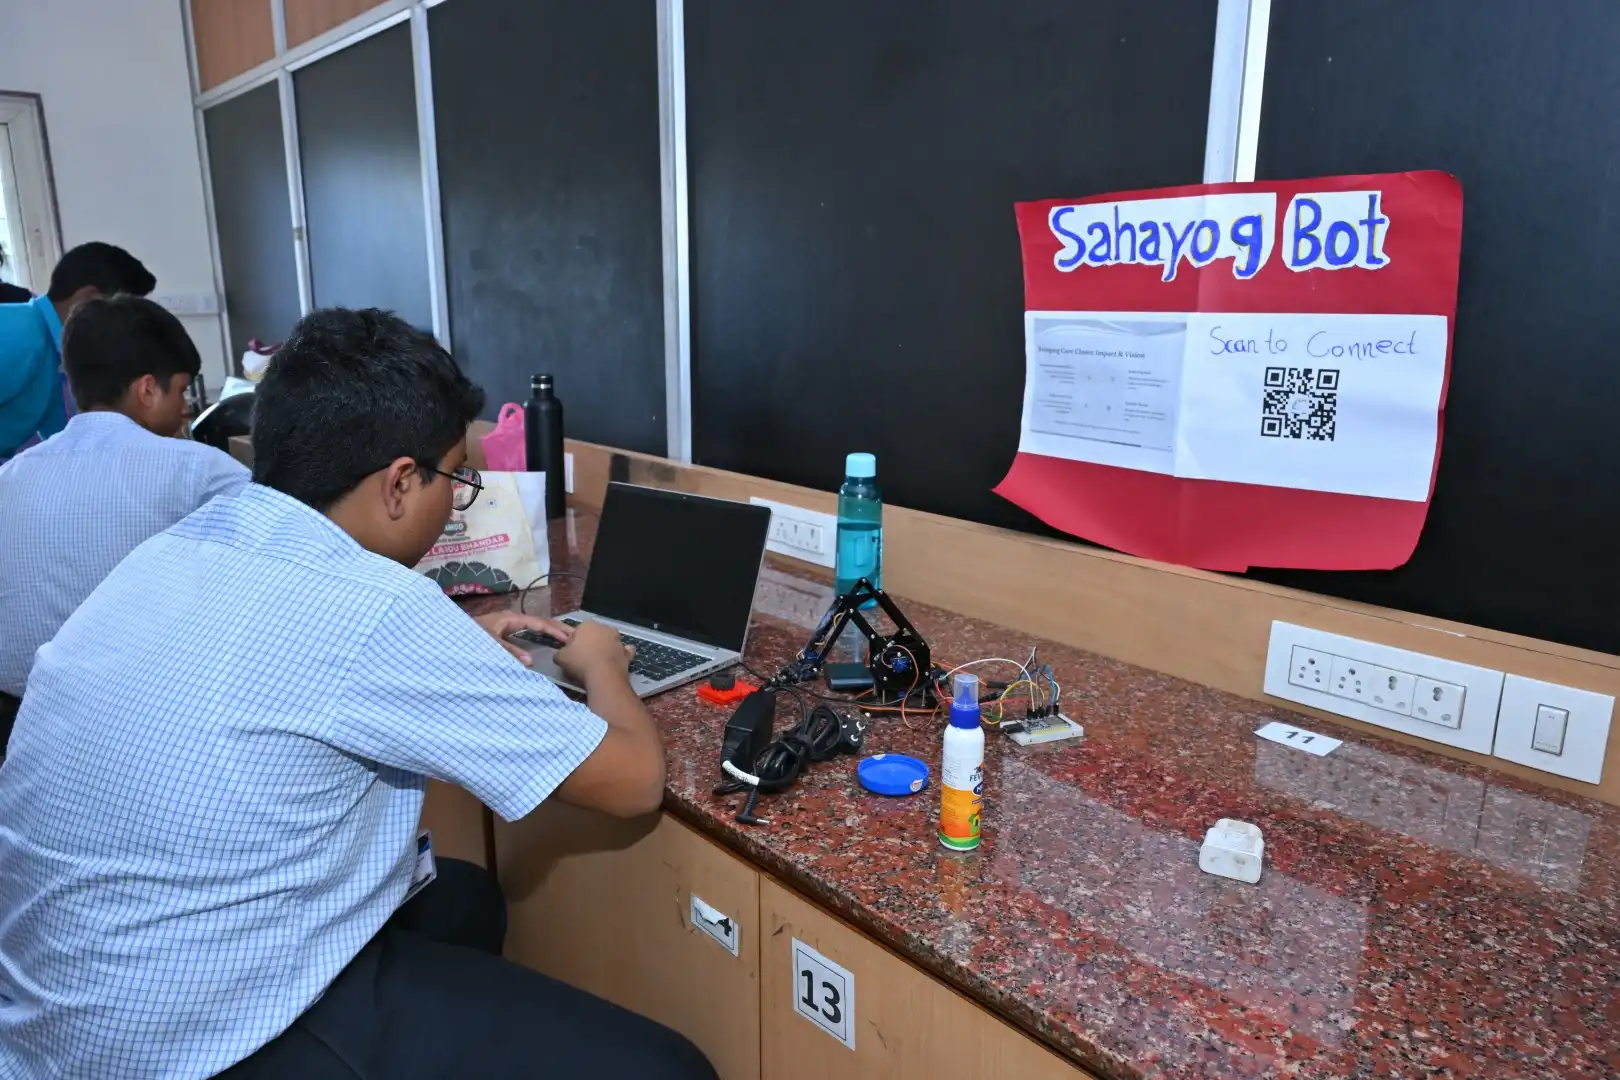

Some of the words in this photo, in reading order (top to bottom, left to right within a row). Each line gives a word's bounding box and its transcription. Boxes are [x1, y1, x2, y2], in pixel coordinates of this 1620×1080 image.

[1052, 205, 1263, 281] Sahayog
[1293, 194, 1386, 267] Bot
[1095, 350, 1117, 358] Impact
[1125, 351, 1145, 359] Vision
[1210, 326, 1258, 355] Scan
[1265, 328, 1288, 354] to
[1306, 330, 1418, 360] Connect
[461, 535, 505, 550] BHANDAR
[801, 969, 842, 1024] 13
